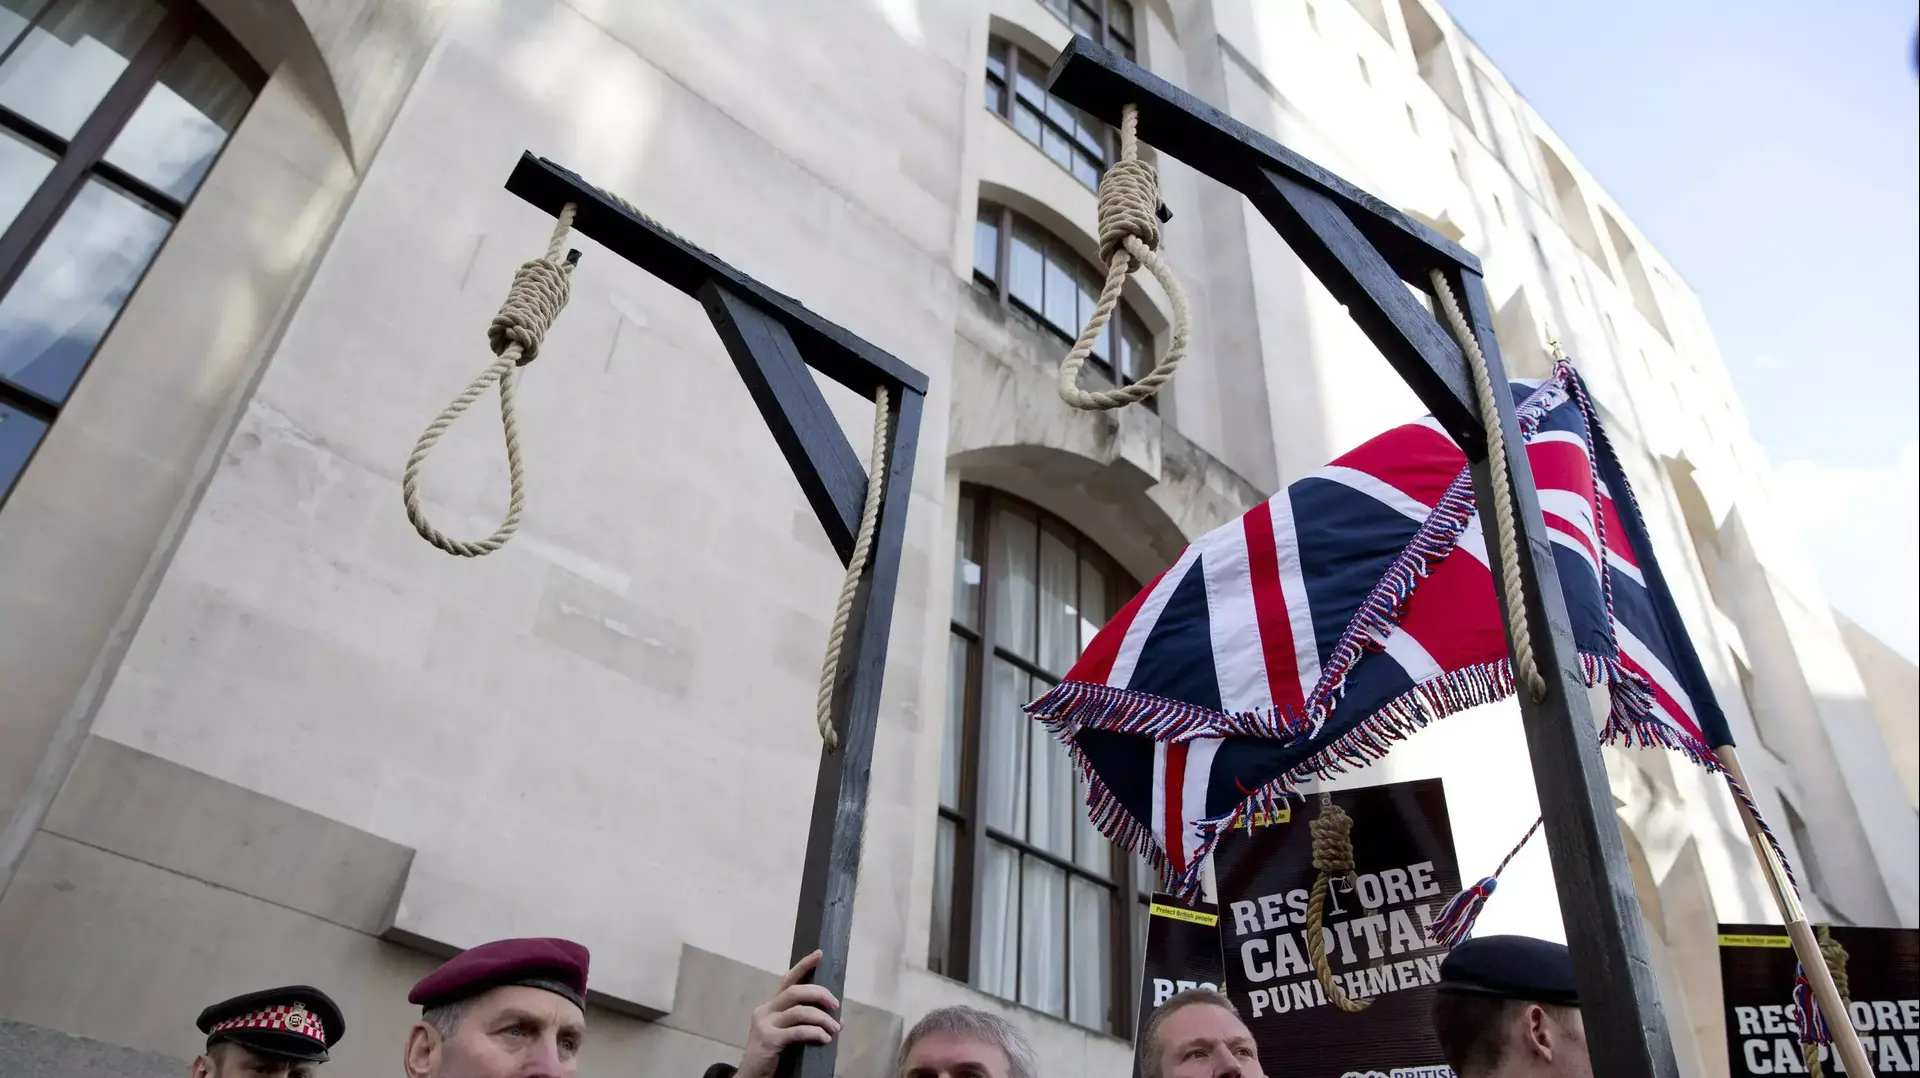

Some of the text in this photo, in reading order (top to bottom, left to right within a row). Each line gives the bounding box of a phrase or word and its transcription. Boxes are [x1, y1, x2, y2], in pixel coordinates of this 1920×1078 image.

[1156, 906, 1213, 923] Protect British people
[1248, 953, 1450, 1018] PUNISHMEN
